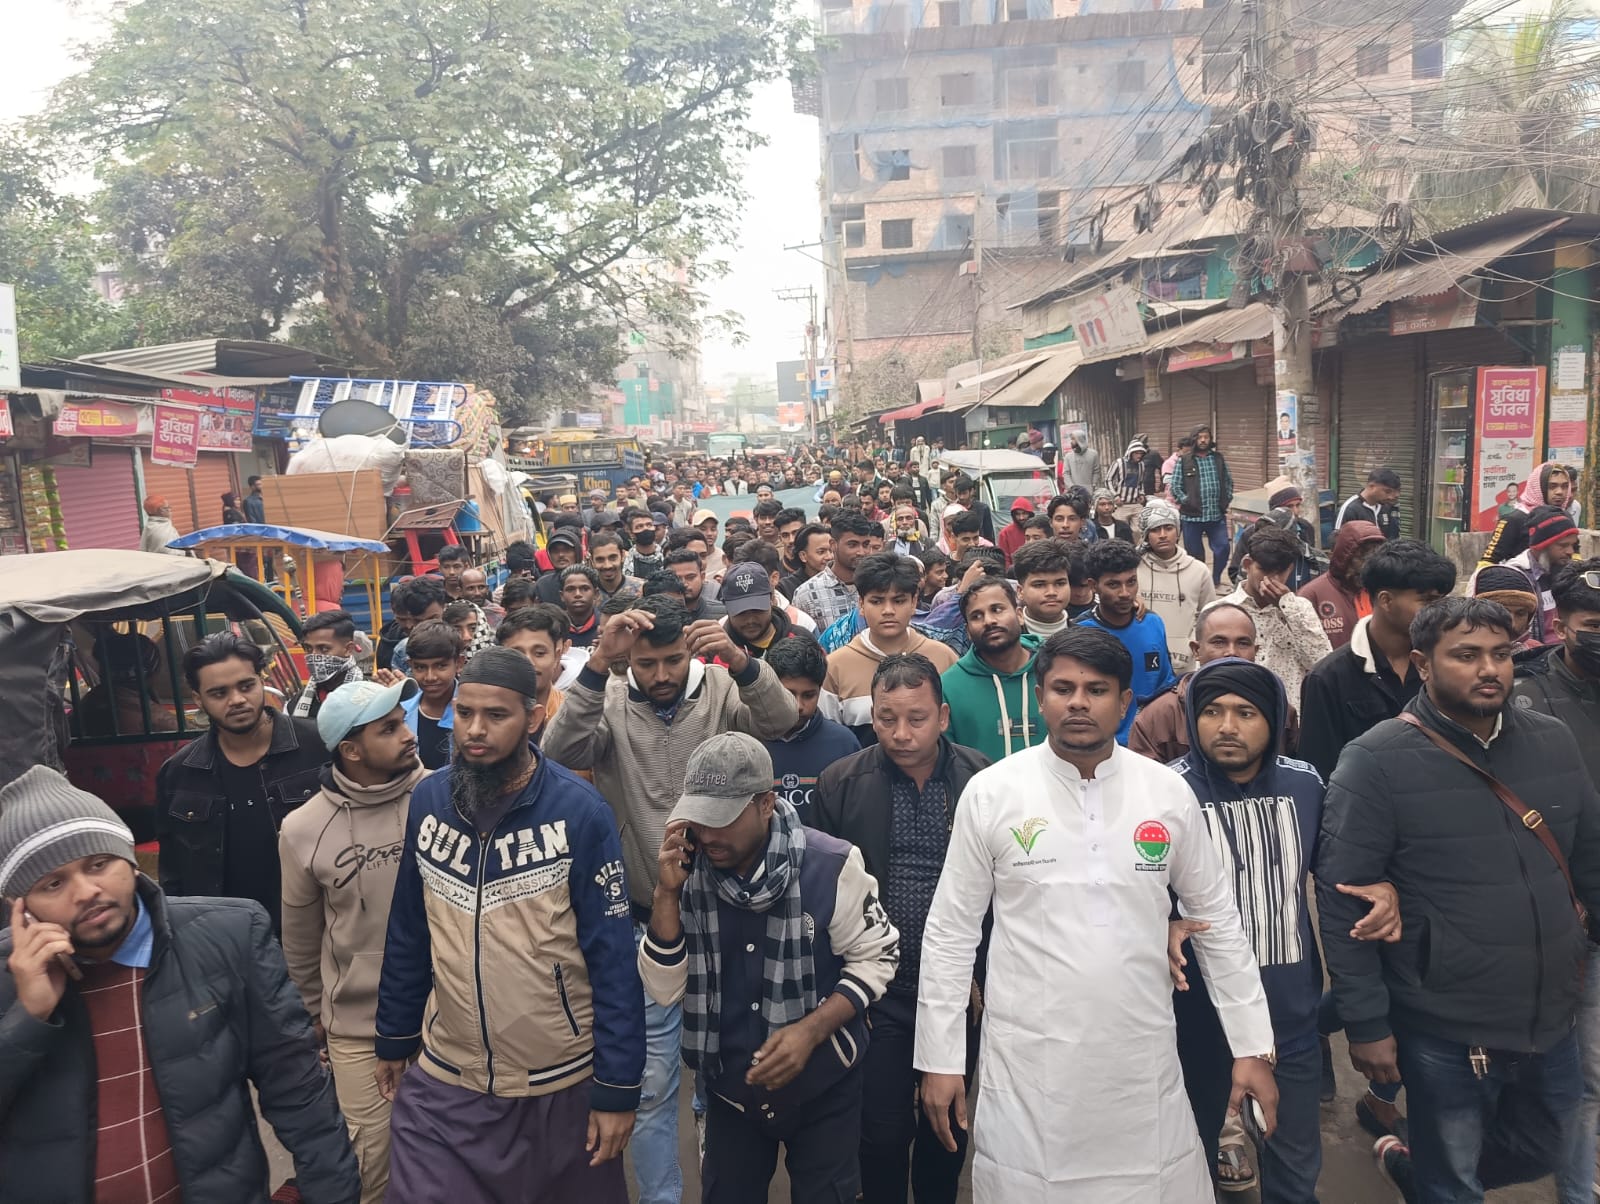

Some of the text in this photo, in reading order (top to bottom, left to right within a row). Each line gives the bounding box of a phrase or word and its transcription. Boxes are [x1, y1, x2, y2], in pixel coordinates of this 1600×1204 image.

[1490, 385, 1531, 404] সুবিধা
[1489, 403, 1530, 416] ডাবল
[159, 417, 195, 436] সুবিধা
[158, 430, 193, 446] ডাবল
[583, 477, 611, 490] Khan
[1141, 591, 1177, 601] MARVEL
[1321, 617, 1344, 629] OSS
[706, 773, 727, 786] free
[502, 874, 551, 895] CLASSIC
[610, 882, 622, 897] S
